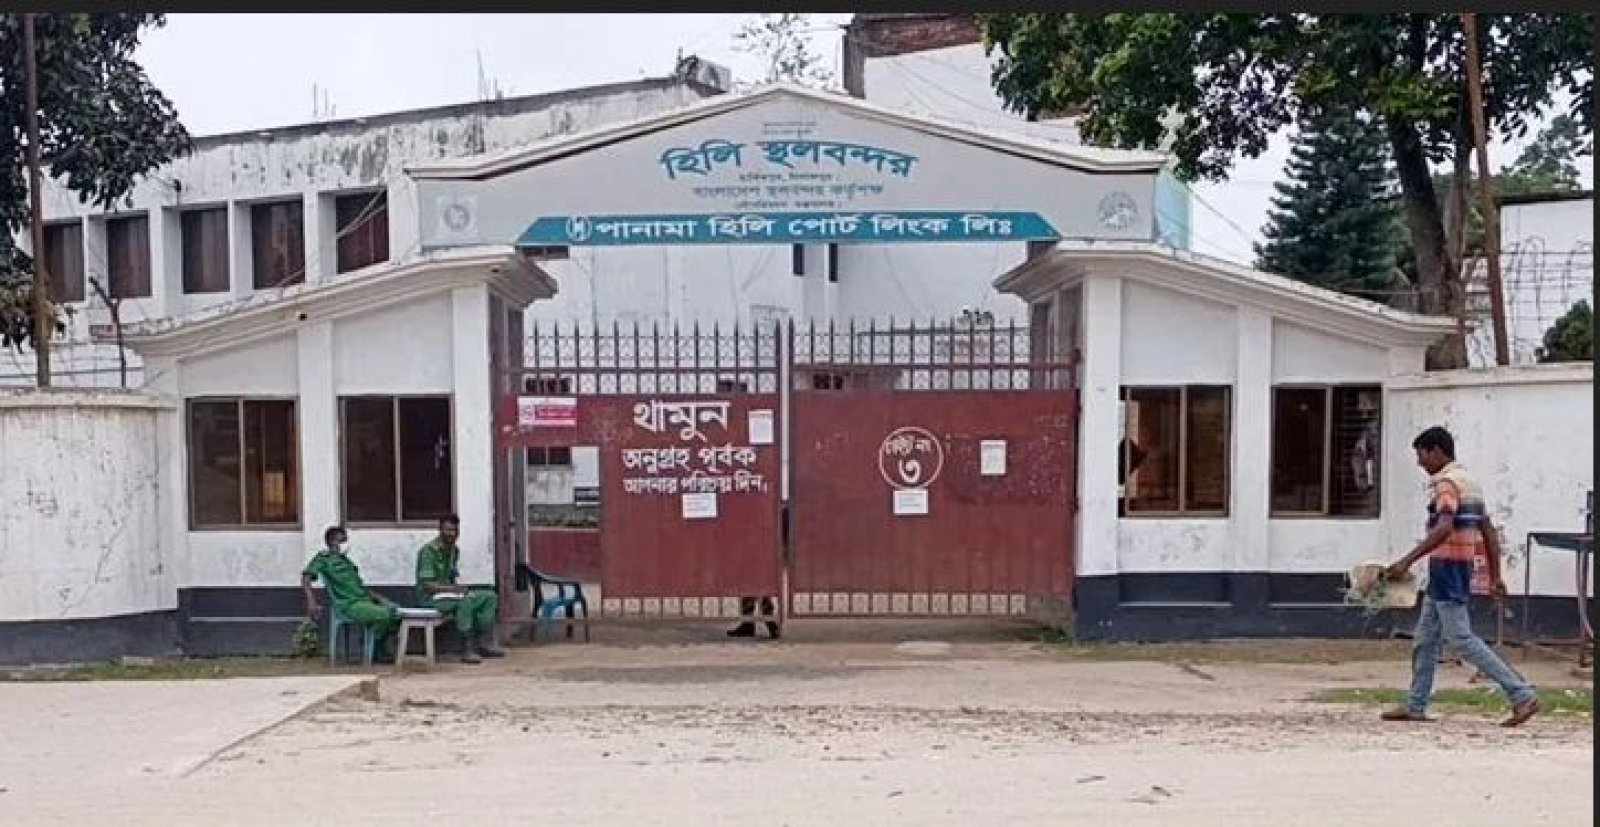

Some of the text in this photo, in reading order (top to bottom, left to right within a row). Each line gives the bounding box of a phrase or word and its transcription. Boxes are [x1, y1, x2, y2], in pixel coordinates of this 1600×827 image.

[661, 138, 919, 179] হিলি স্থলবন্দর
[595, 214, 1012, 239] পানামা হিলি পোর্ট লিংক লিঃ
[632, 400, 731, 442] থামুন
[621, 442, 757, 474] অনুগ্রহ পূর্বক
[899, 459, 920, 483] ৩
[622, 476, 678, 494] আপনার
